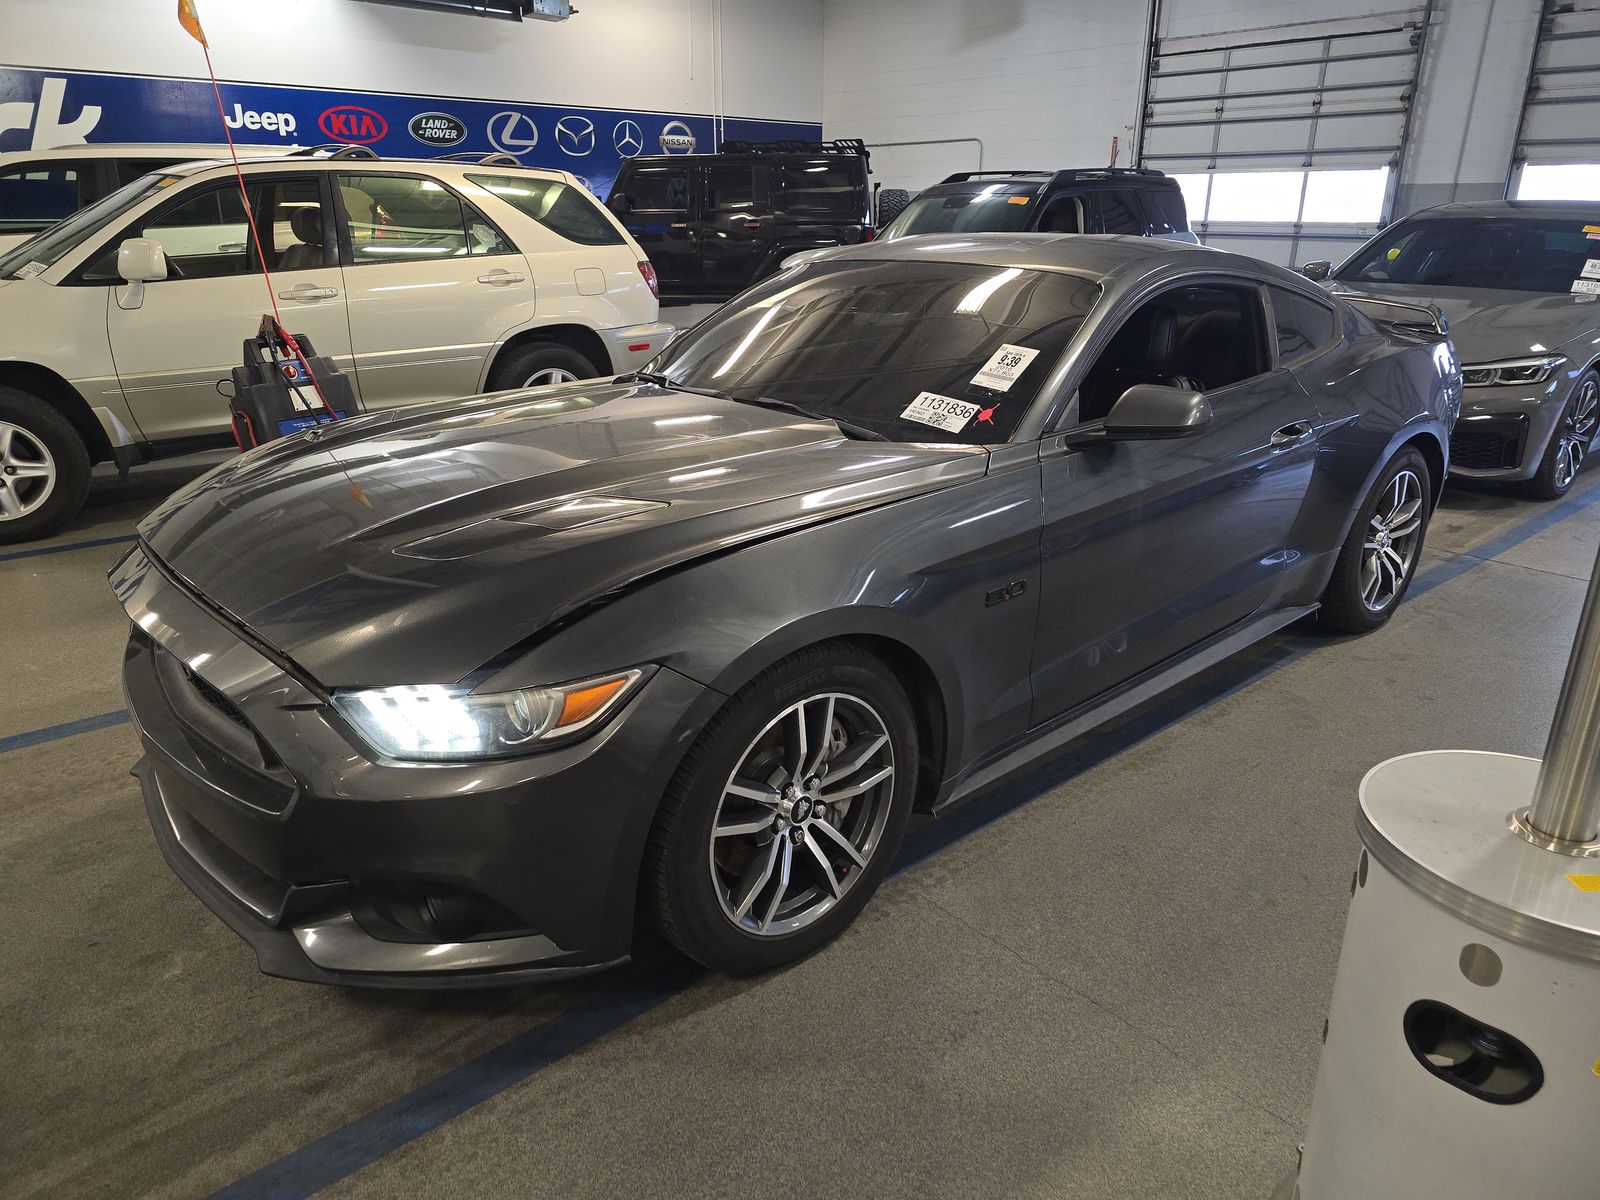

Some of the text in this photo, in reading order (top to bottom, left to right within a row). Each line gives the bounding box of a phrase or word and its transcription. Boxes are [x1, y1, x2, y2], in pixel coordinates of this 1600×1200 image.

[225, 104, 297, 137] Jeep
[329, 113, 378, 137] KIA
[421, 119, 449, 129] LAND
[425, 129, 458, 139] ROVER
[662, 138, 693, 146] NISSAN
[997, 354, 1022, 368] 9:39
[920, 396, 975, 419] 1131836
